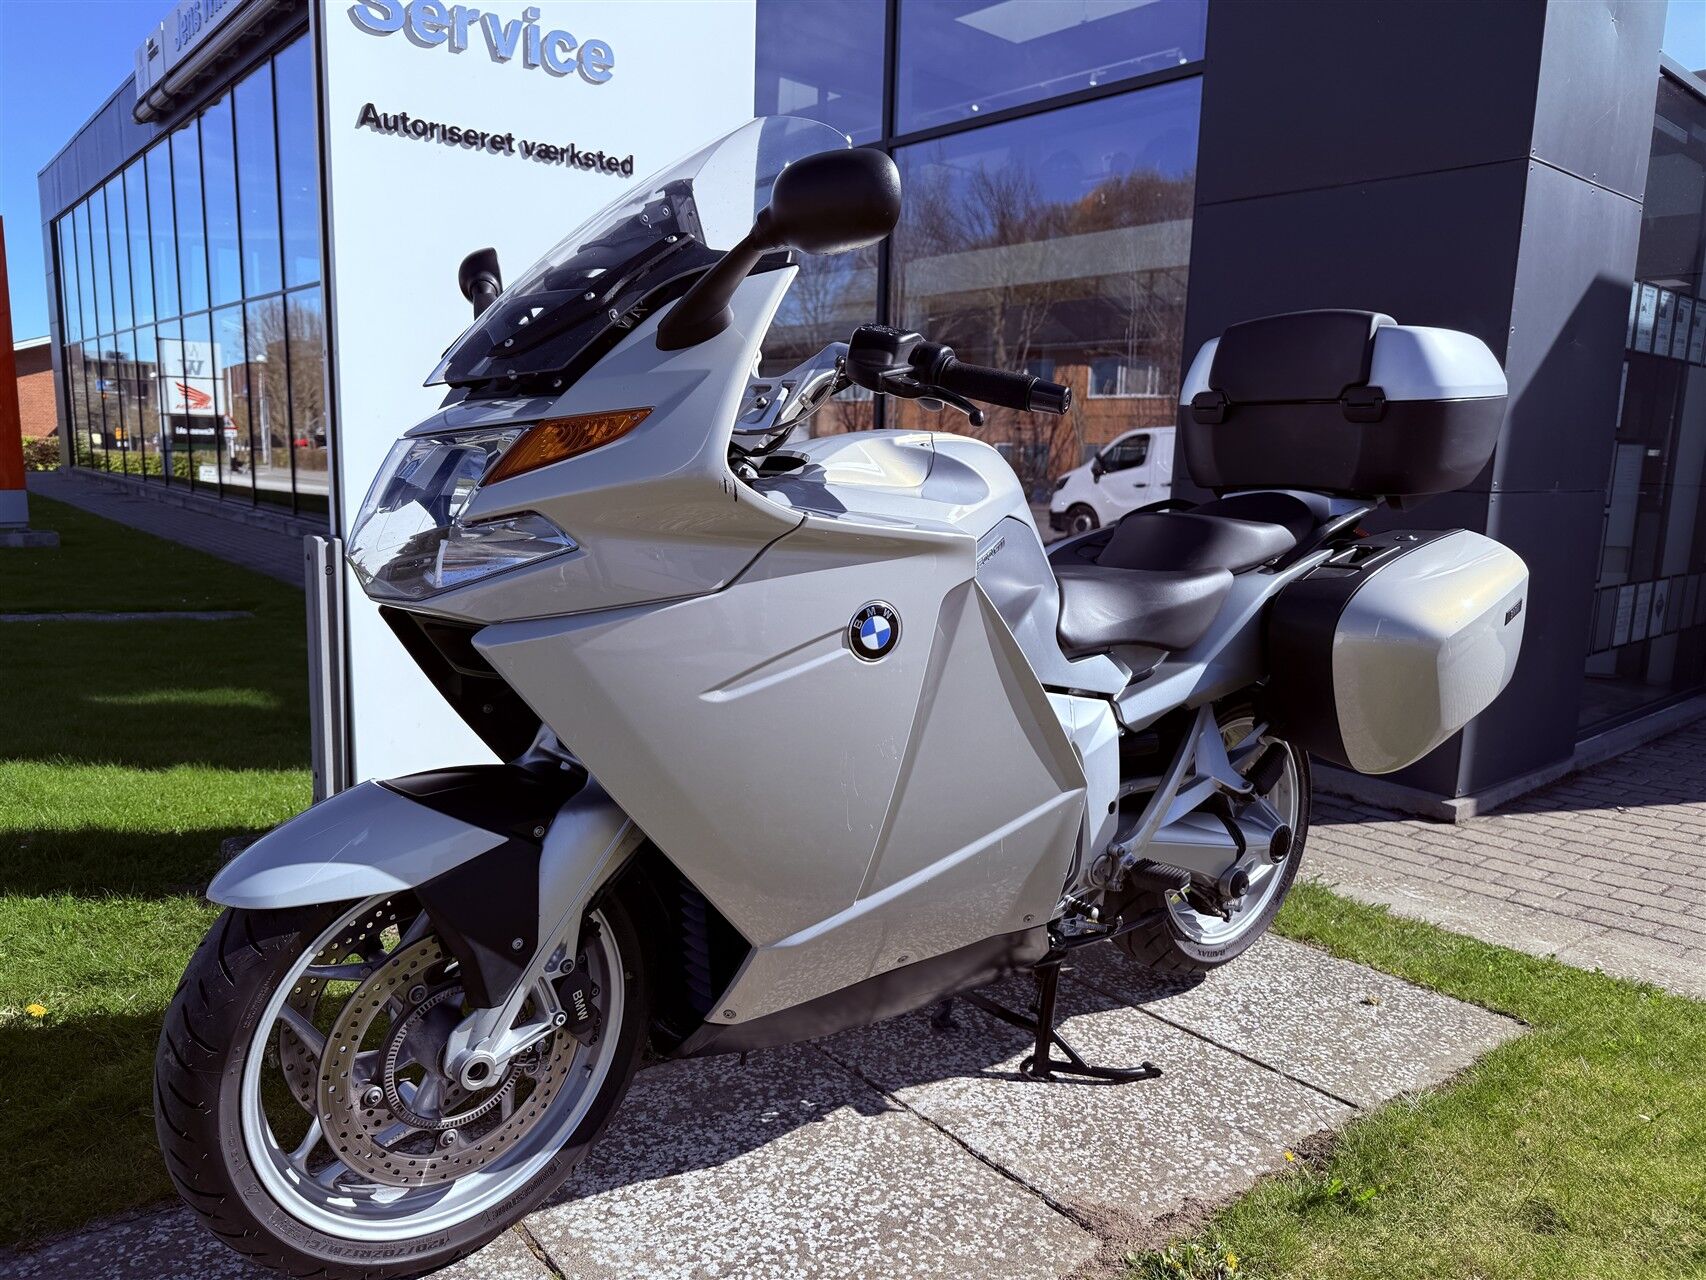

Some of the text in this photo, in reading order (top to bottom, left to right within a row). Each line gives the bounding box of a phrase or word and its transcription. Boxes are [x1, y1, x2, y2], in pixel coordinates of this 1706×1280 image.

[347, 0, 615, 85] Service
[355, 102, 634, 178] Autoriseret værksted
[853, 606, 894, 631] BMW
[572, 989, 589, 1020] BMW
